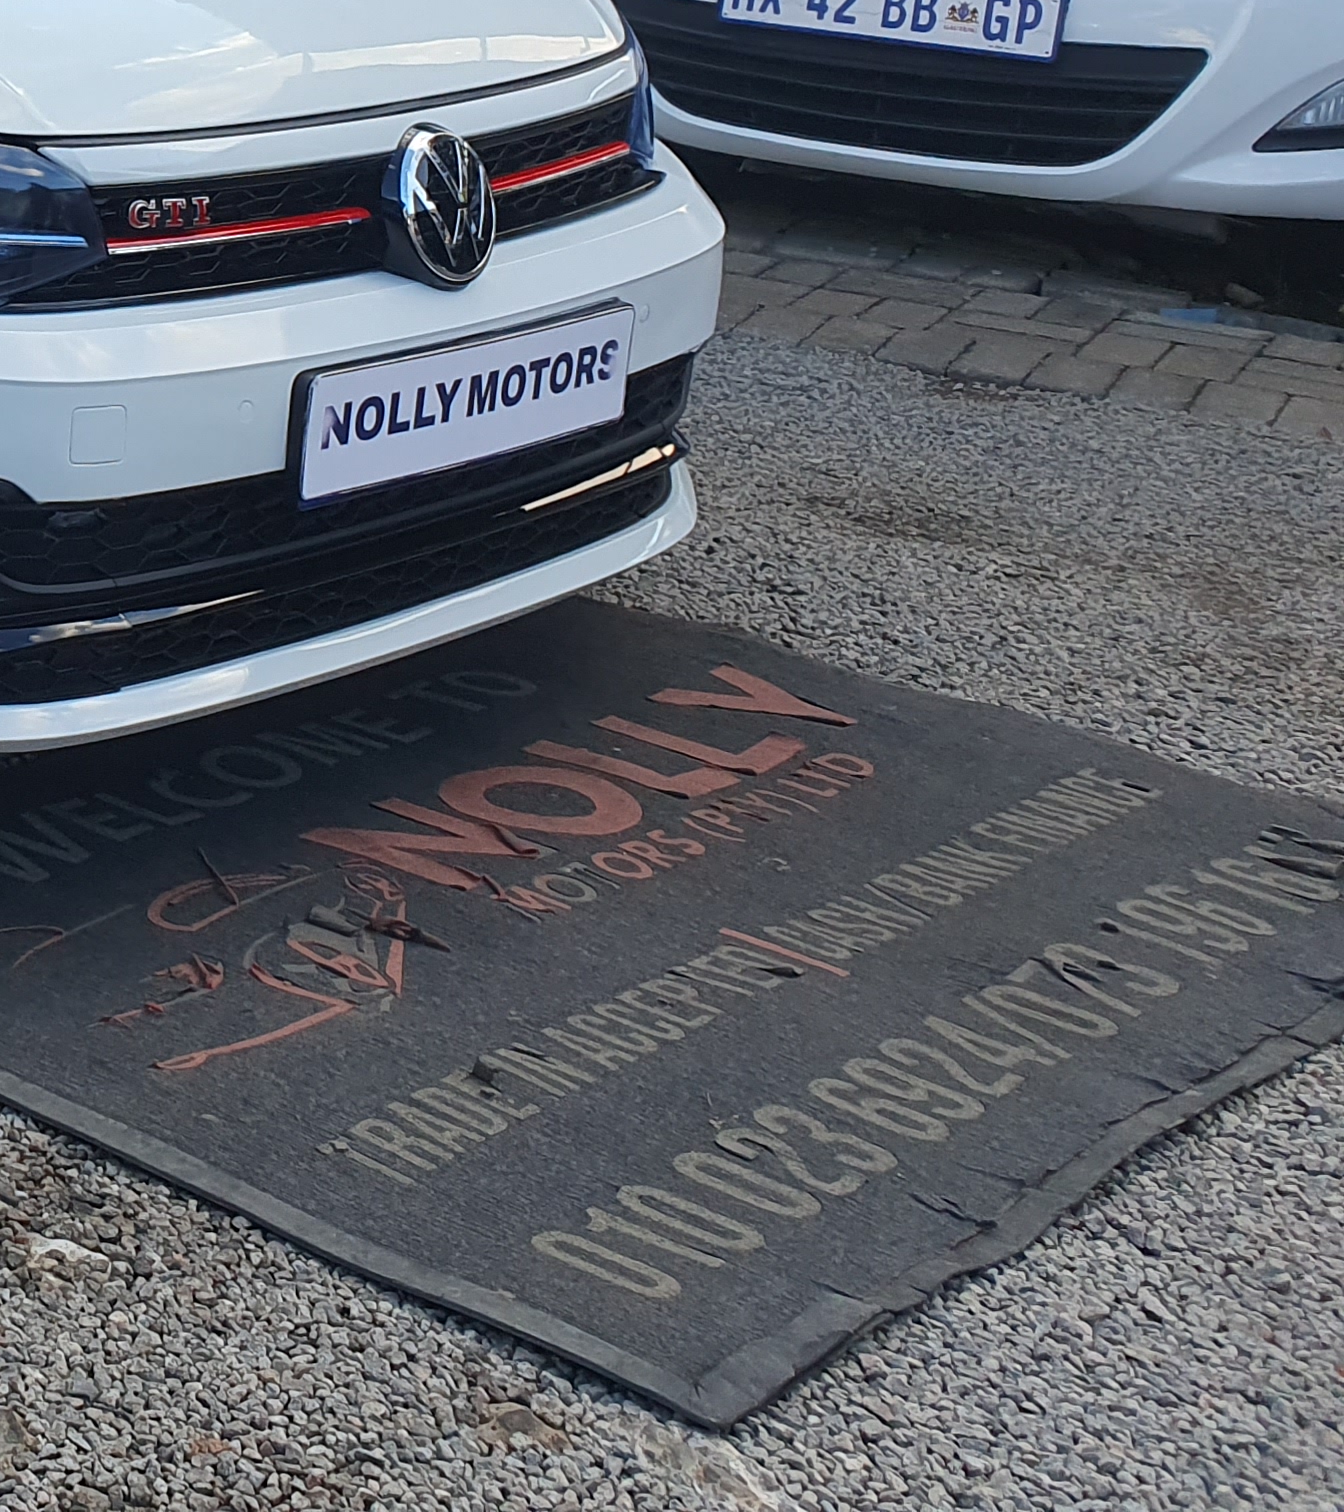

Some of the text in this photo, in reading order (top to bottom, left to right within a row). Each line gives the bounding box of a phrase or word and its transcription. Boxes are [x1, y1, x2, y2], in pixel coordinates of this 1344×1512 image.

[128, 195, 211, 229] GTI
[320, 338, 620, 450] NOLLY MOTORS
[389, 670, 538, 714] TO
[300, 662, 858, 890] NOLLY
[489, 829, 705, 923] MOTORS
[315, 1069, 541, 1184] TRADE
[483, 1043, 595, 1098] IN
[541, 944, 805, 1071] ACCEPTED
[970, 768, 1164, 852] FINANCE
[531, 1185, 766, 1300] 010
[673, 1104, 899, 1219] 023
